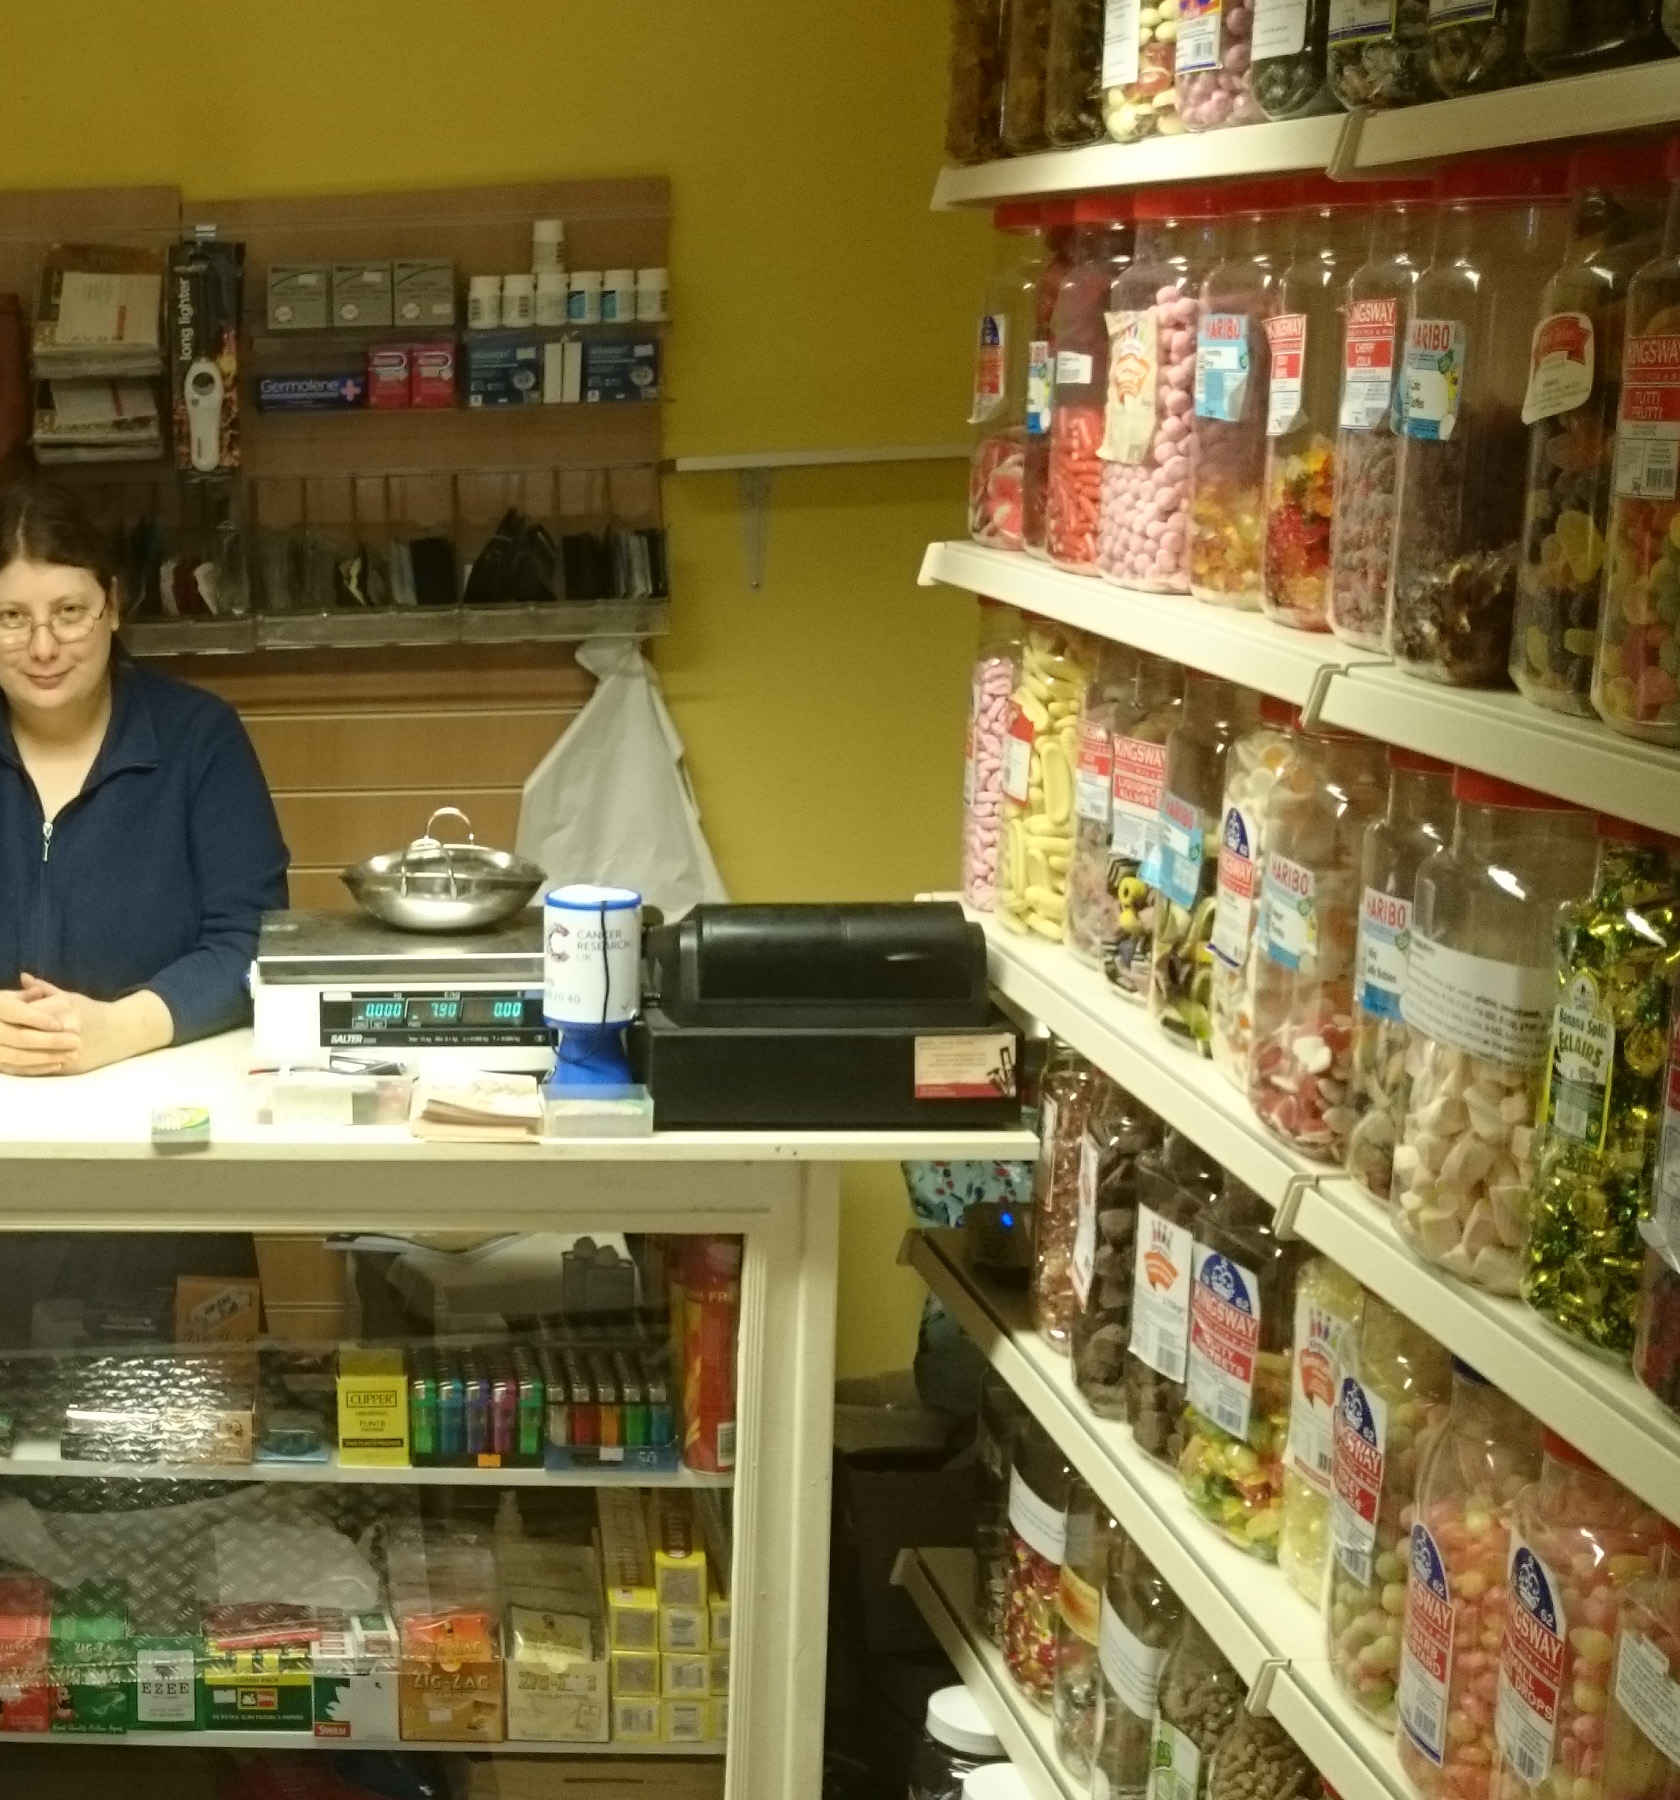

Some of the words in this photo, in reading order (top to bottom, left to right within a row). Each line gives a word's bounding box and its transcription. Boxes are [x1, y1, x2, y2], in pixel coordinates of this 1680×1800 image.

[178, 277, 195, 324] lighter
[179, 328, 193, 360] long
[260, 379, 339, 394] Germolene
[330, 1034, 363, 1045] SALTER
[141, 1682, 190, 1694] EZEE
[413, 1674, 489, 1690] ZIG-ZAG
[318, 1724, 346, 1736] SWAN
